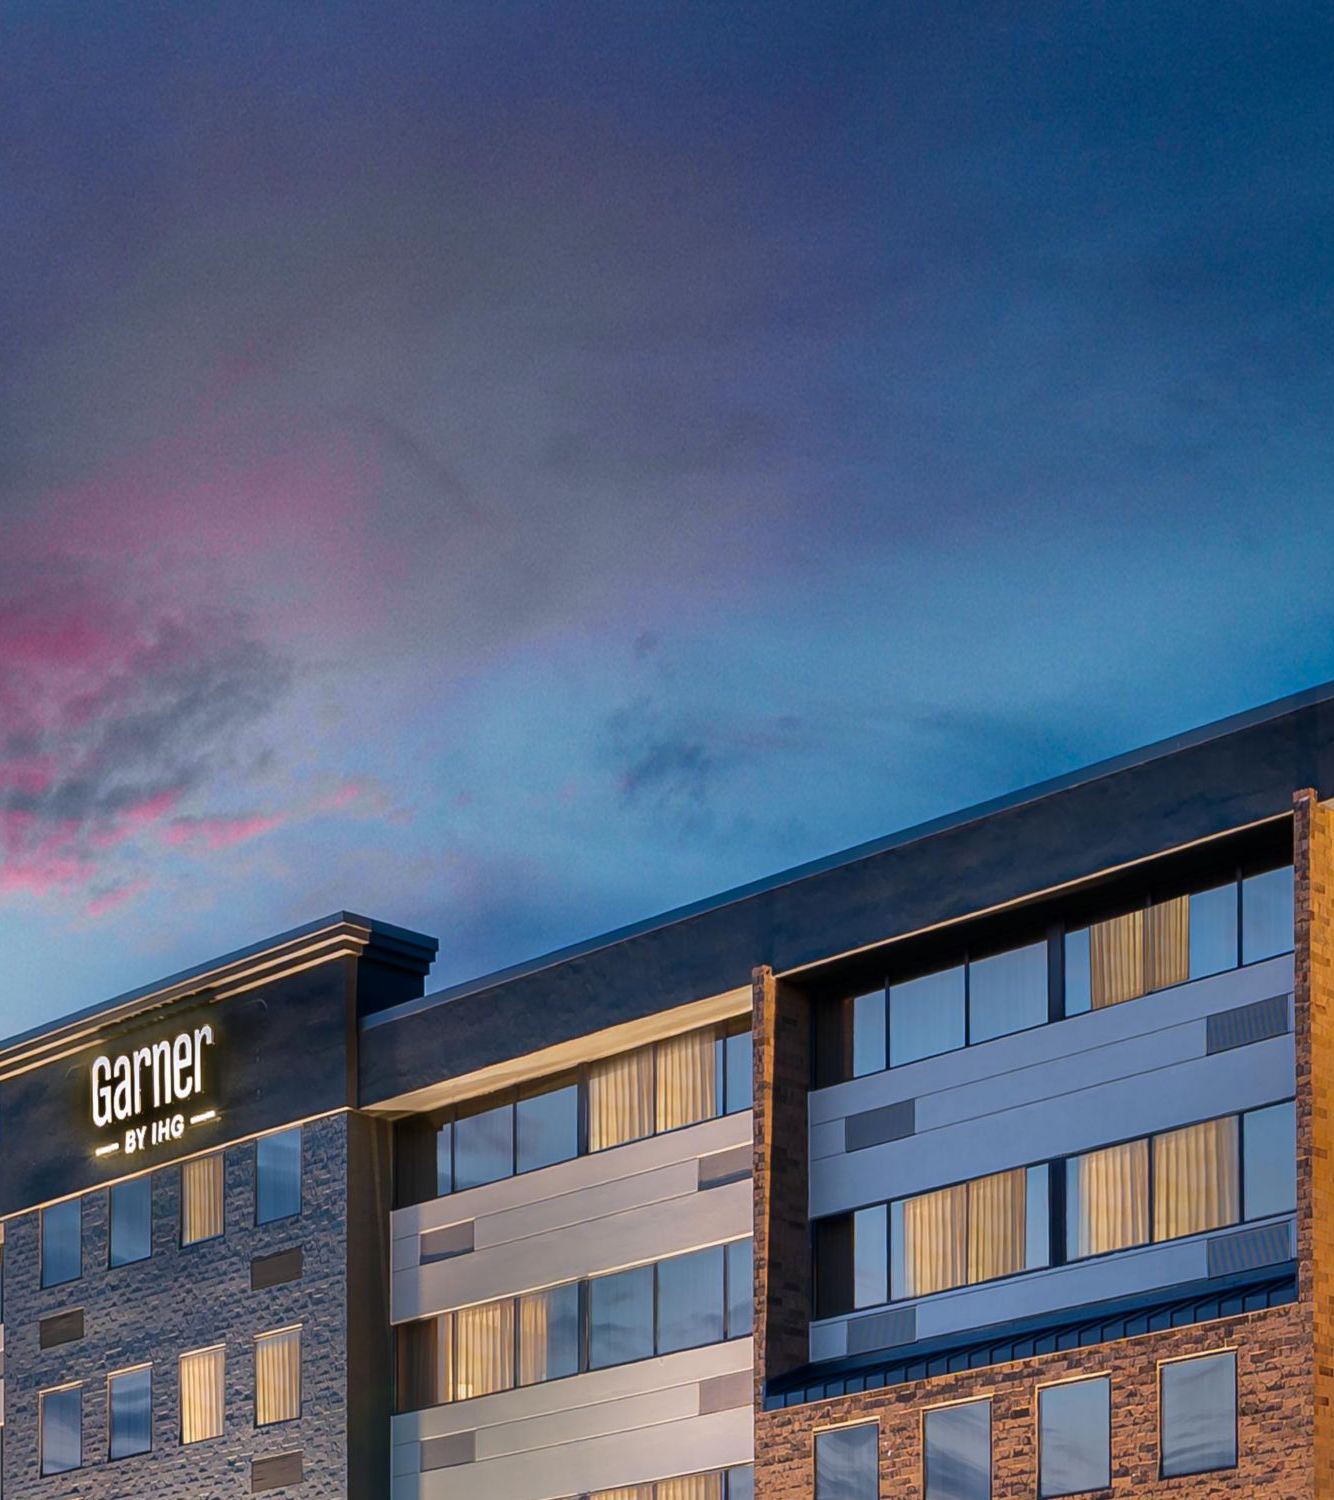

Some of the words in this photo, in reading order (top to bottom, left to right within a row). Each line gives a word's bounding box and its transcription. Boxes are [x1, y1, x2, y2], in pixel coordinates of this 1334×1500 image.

[91, 1024, 213, 1128] Garner
[124, 1125, 148, 1154] BY
[151, 1113, 185, 1146] IHG
